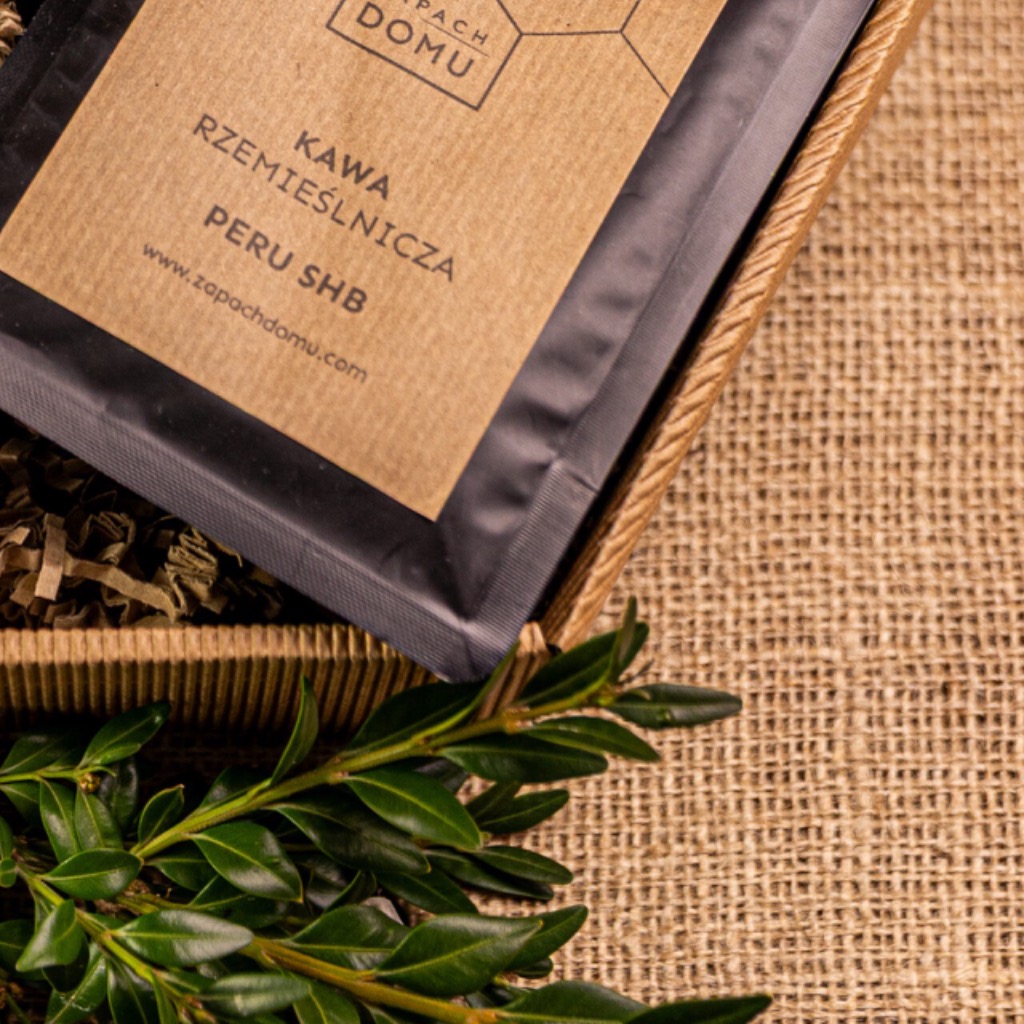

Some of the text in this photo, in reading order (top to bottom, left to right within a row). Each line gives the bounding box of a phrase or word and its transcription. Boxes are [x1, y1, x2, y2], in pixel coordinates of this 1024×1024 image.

[355, 1, 475, 78] DOMU
[192, 113, 456, 283] RZEMIEŚLNICZA
[293, 129, 391, 201] KAWA
[142, 242, 368, 384] www.zapachdomu.com
[203, 204, 369, 315] PERU SHB
